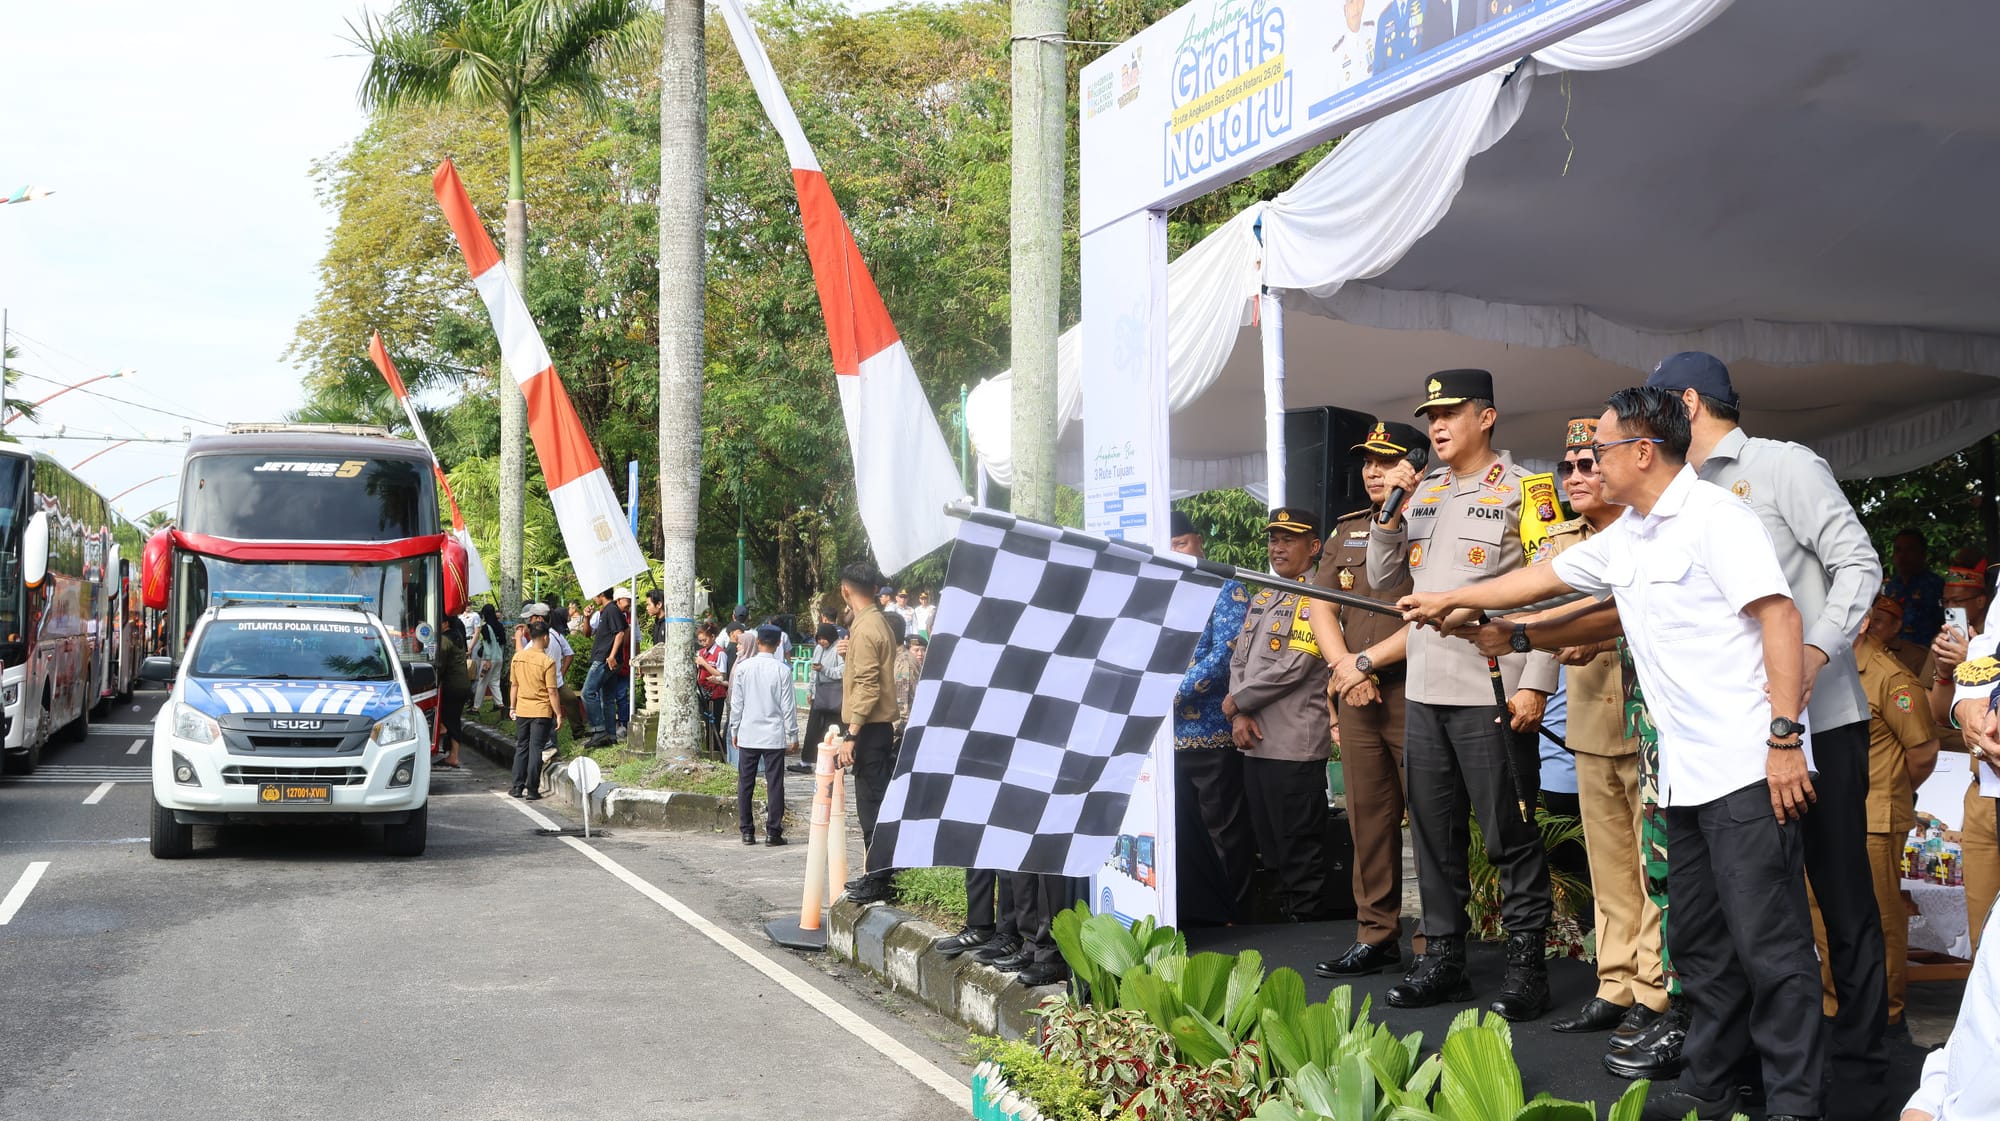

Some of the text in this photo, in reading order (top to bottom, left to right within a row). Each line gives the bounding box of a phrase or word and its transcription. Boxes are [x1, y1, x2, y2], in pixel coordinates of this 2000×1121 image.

[1171, 0, 1285, 109] Gratis
[1173, 62, 1282, 128] 3 rute Angkutan Bus Gratis Nataru 25/26
[1164, 69, 1293, 187] Nataru
[253, 461, 340, 472] JETBUS
[335, 460, 368, 478] 5
[1094, 469, 1099, 480] 3
[1098, 467, 1112, 480] Rute
[1411, 506, 1437, 518] IWAN
[1467, 506, 1504, 520] POLRI
[1273, 609, 1293, 618] POLRI
[238, 622, 369, 634] DITLANTAS POLDA KALTENG 501
[212, 682, 375, 692] POLISI
[273, 719, 321, 729] ISUZU
[286, 787, 327, 799] 127001-XVIII
